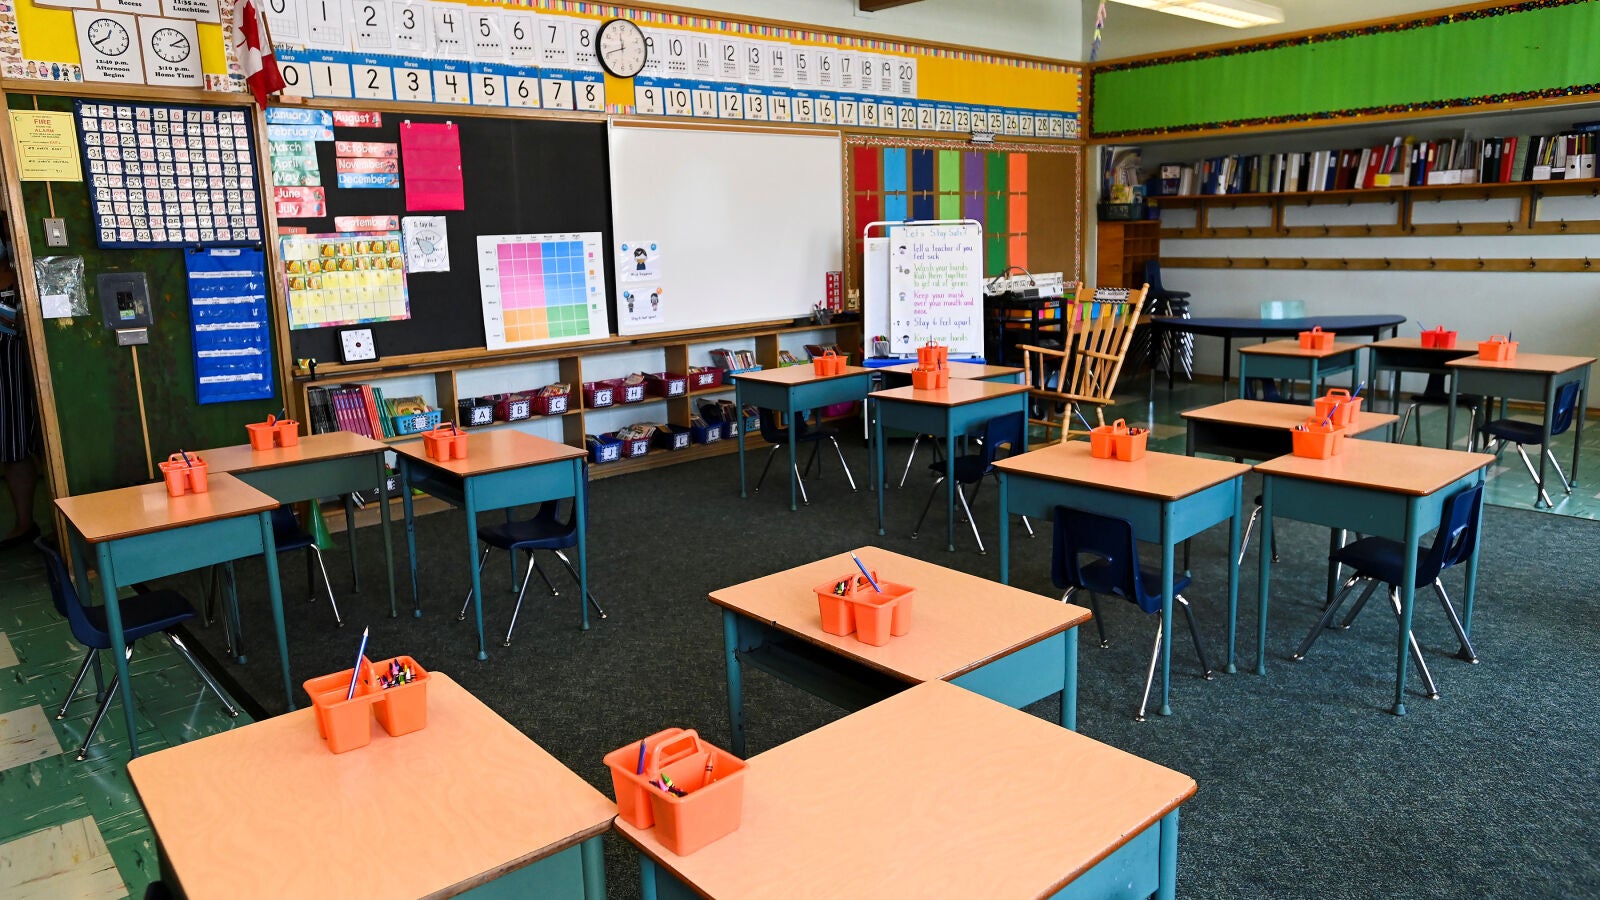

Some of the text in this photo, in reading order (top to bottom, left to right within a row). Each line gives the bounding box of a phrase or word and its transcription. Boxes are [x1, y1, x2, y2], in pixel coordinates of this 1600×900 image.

[172, 5, 210, 14] Lunchtime
[322, 1, 327, 21] 1
[363, 6, 377, 27] 2
[402, 9, 415, 29] 3
[443, 13, 454, 33] 4
[480, 18, 491, 37] 5
[513, 21, 525, 40] 6
[547, 25, 557, 44] 7
[580, 29, 590, 47] 8
[646, 37, 913, 80] 9 10 11 12 13 14 15 16 17 18 19 20
[283, 65, 595, 102] 0 1 2 3 4 5 6 7 8
[103, 107, 109, 115] 2
[158, 111, 163, 119] 5
[174, 112, 179, 120] 6
[205, 113, 211, 121] 8
[268, 108, 311, 121] January
[645, 89, 654, 106] 9
[670, 90, 686, 107] 10
[699, 92, 712, 109] 11
[724, 94, 738, 111] 12
[749, 96, 762, 112] 13
[773, 98, 786, 114] 14
[797, 100, 810, 115] 15
[820, 102, 831, 117] 16
[841, 103, 853, 118] 17
[863, 105, 874, 119] 18
[883, 107, 893, 120] 19
[901, 108, 915, 122] 20
[922, 109, 932, 124] 21
[940, 110, 952, 125] 22
[957, 112, 969, 126] 23
[973, 113, 985, 127] 24
[990, 114, 1001, 128] 25
[1006, 116, 1017, 129] 26
[1022, 117, 1032, 130] 27
[1038, 118, 1048, 131] 28
[1052, 119, 1062, 132] 29
[1065, 121, 1076, 133] 30
[335, 112, 370, 125] August
[157, 124, 167, 132] 15
[268, 126, 318, 138] February
[105, 136, 117, 145] 22
[269, 142, 302, 152] March
[337, 143, 379, 153] October
[89, 149, 100, 157] 31
[274, 158, 299, 171] April
[339, 160, 385, 170] November
[274, 171, 300, 183] May
[339, 174, 387, 185] December
[161, 178, 172, 187] 55
[278, 189, 301, 199] June
[100, 204, 111, 212] 71
[278, 202, 299, 215] July
[337, 218, 386, 229] Septemb
[103, 231, 114, 240] 91
[905, 227, 925, 238] Let's
[930, 228, 947, 239] Stay
[913, 243, 923, 252] Tell
[932, 243, 953, 252] teacher
[956, 243, 961, 252] if
[913, 263, 934, 272] Wash
[935, 265, 948, 273] your
[928, 271, 943, 279] them
[945, 272, 968, 280] together
[942, 279, 948, 287] of
[913, 290, 964, 301] Keep your mask
[929, 301, 941, 309] your
[943, 299, 961, 307] mouth
[963, 297, 974, 306] and
[914, 317, 930, 329] Stay
[940, 316, 951, 326] feet
[953, 315, 971, 328] apart
[600, 394, 607, 402] G
[555, 400, 561, 409] C
[517, 406, 523, 414] B
[479, 411, 486, 420] A
[608, 448, 613, 457] J
[637, 443, 643, 452] K
